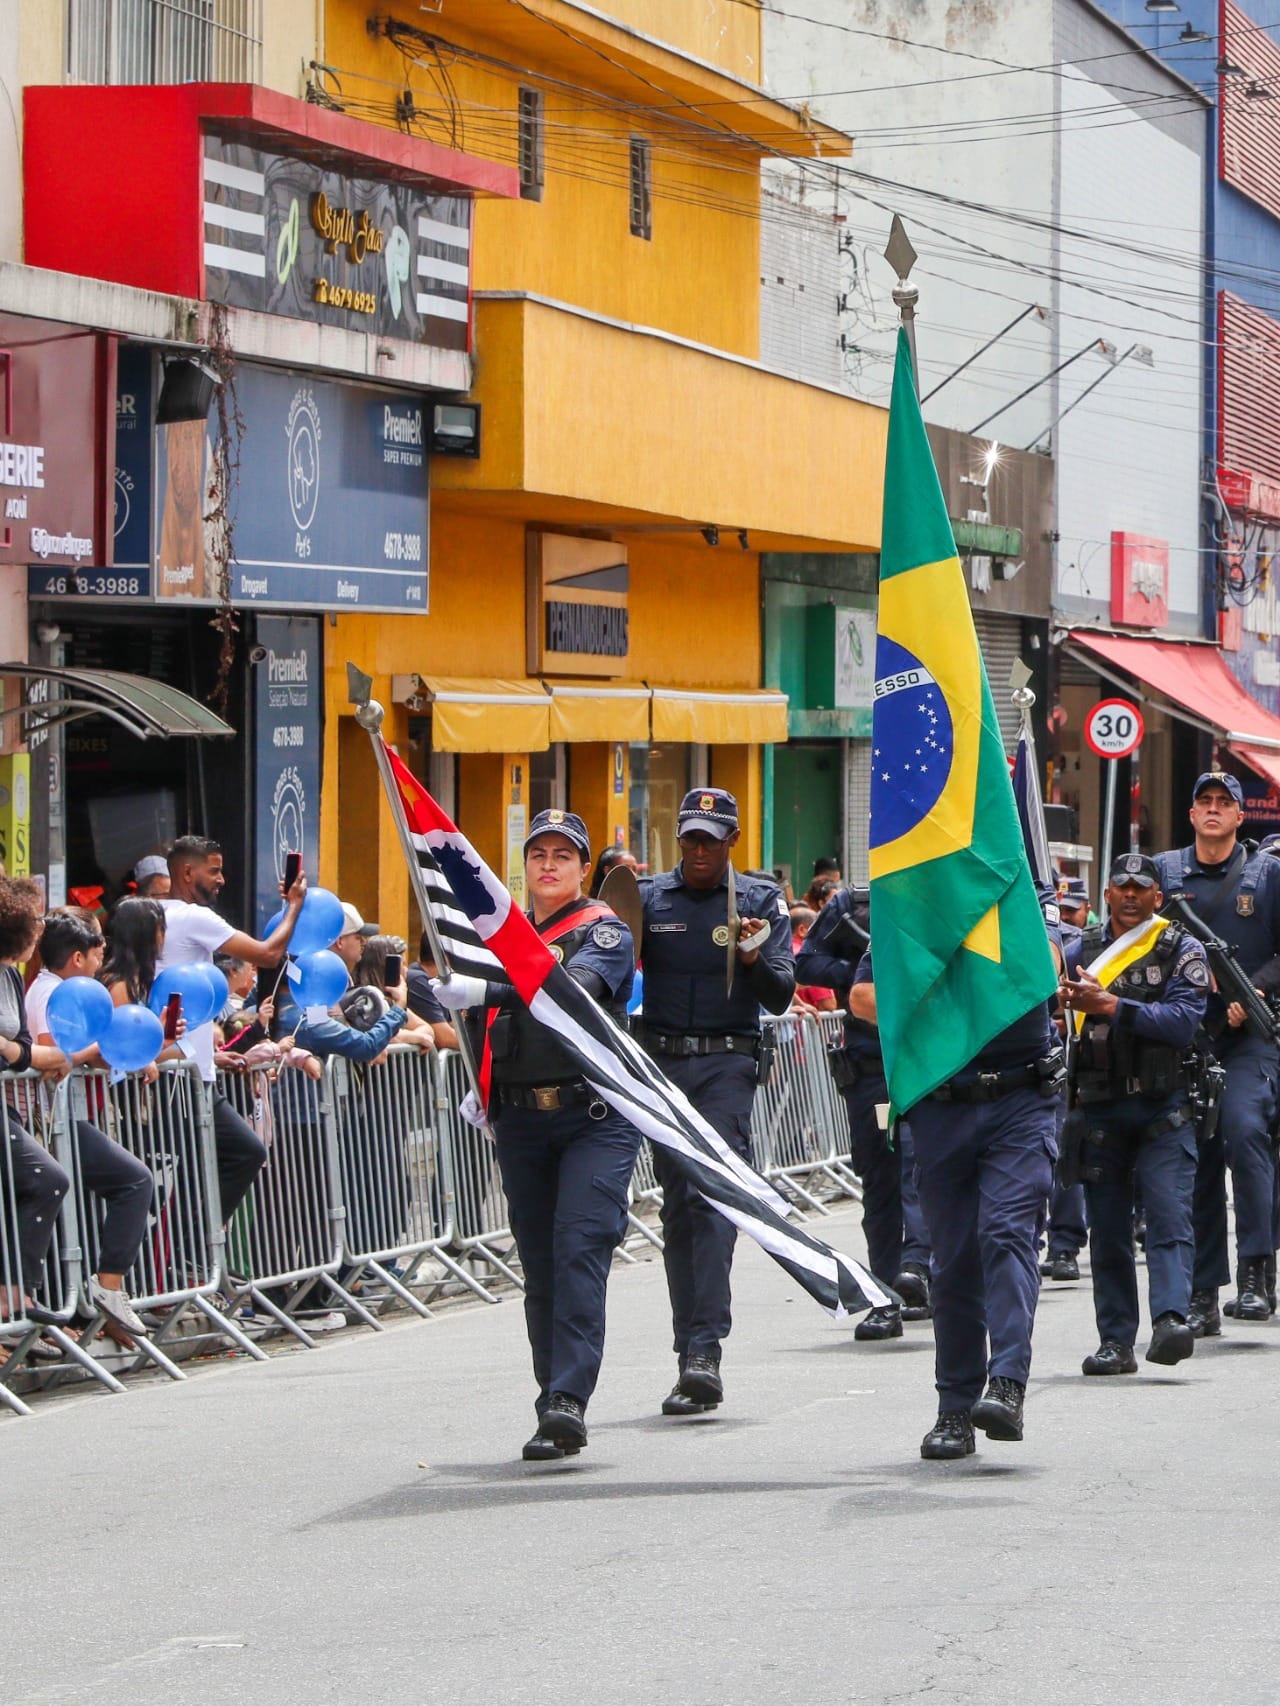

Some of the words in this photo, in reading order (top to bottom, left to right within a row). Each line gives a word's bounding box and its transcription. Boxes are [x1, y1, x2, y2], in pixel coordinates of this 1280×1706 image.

[45, 577, 139, 594] 468-3988
[337, 580, 359, 602] Delivery
[269, 650, 308, 681] PremieR
[1096, 714, 1132, 738] 30
[1102, 740, 1125, 748] km/h
